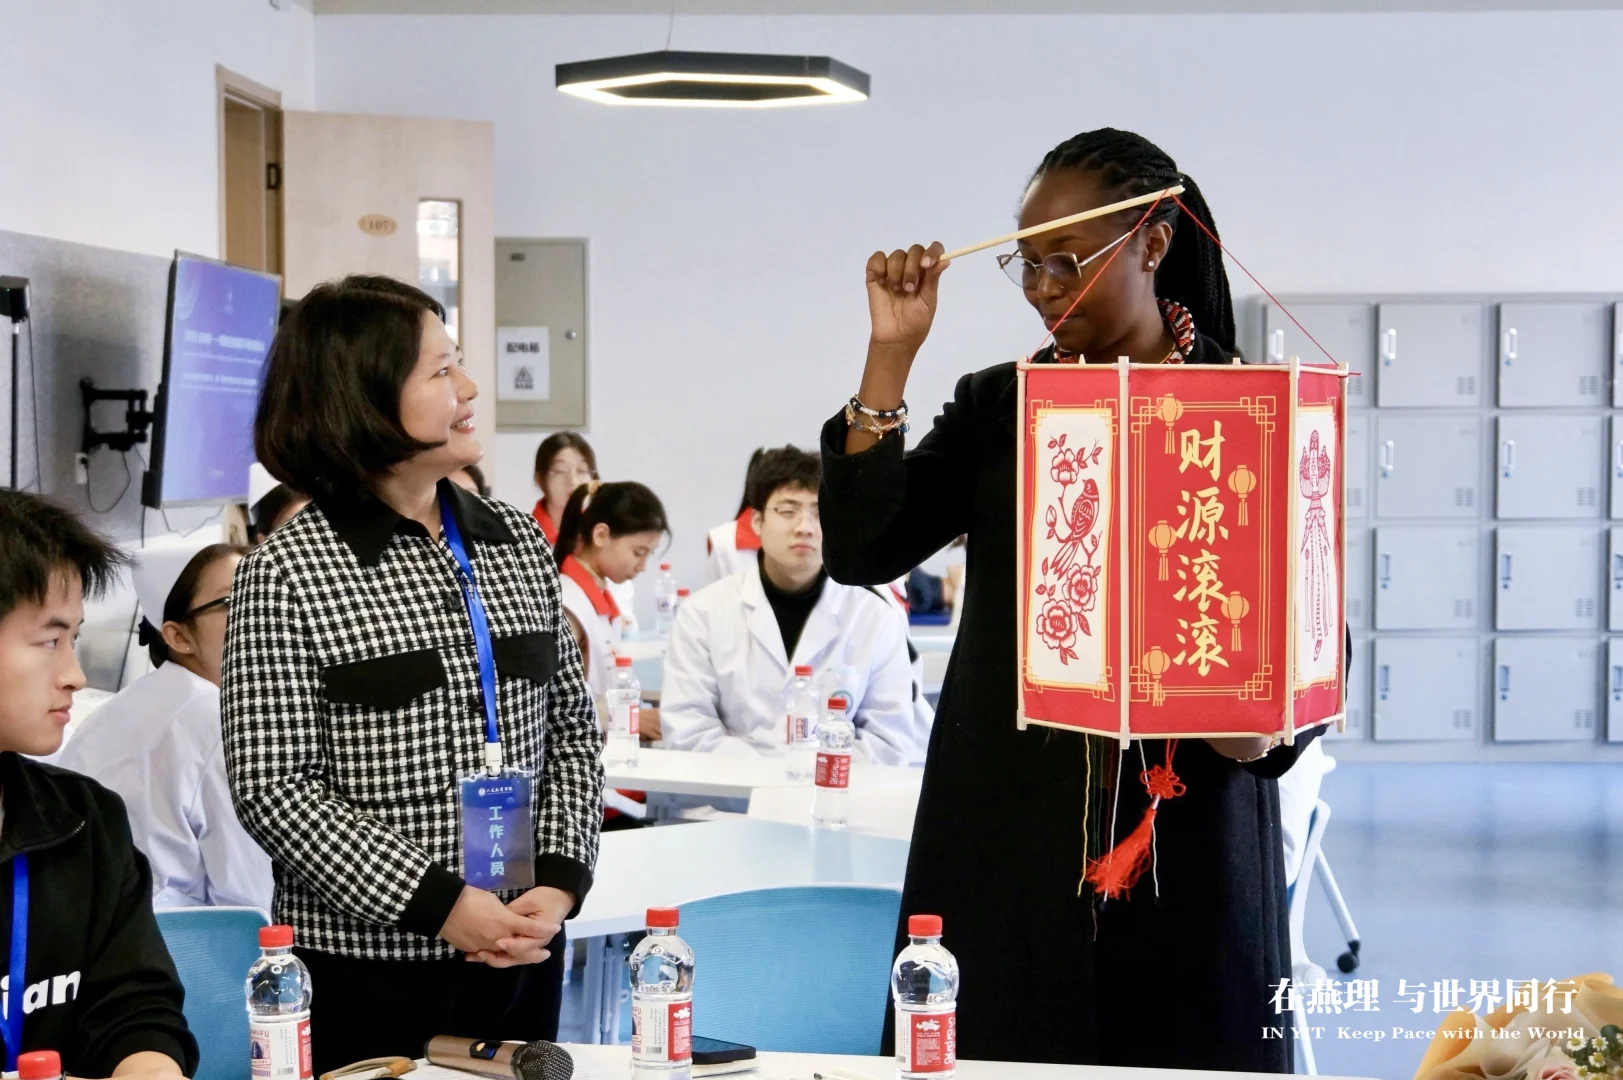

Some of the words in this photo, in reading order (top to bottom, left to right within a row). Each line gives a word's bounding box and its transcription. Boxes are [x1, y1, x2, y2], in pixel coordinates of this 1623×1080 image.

[1172, 420, 1230, 677] 财源滚滚
[489, 806, 505, 877] 工作人员
